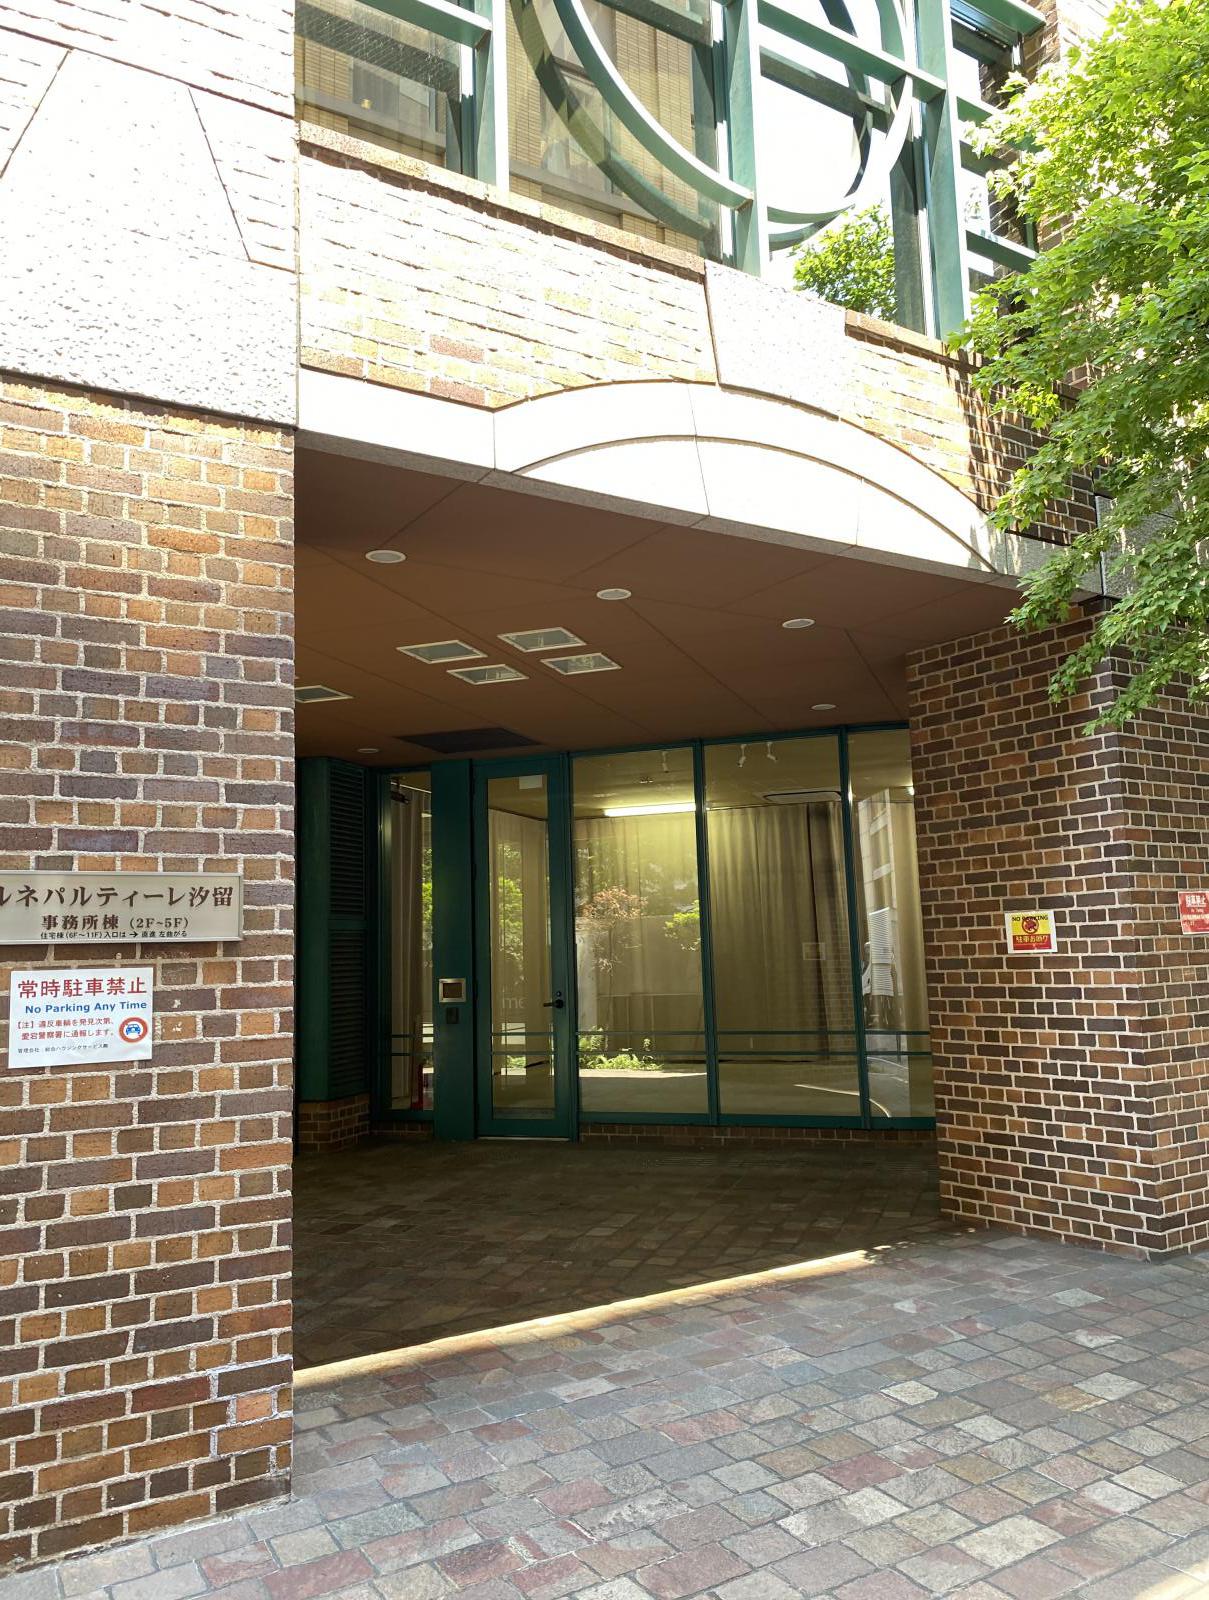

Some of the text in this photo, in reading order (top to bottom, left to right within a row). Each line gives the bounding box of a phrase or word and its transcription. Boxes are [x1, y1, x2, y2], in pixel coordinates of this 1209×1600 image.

[41, 915, 119, 931] 事務所棟
[18, 977, 148, 999] 常時駐車禁止
[25, 1001, 147, 1014] No Parking Any Time
